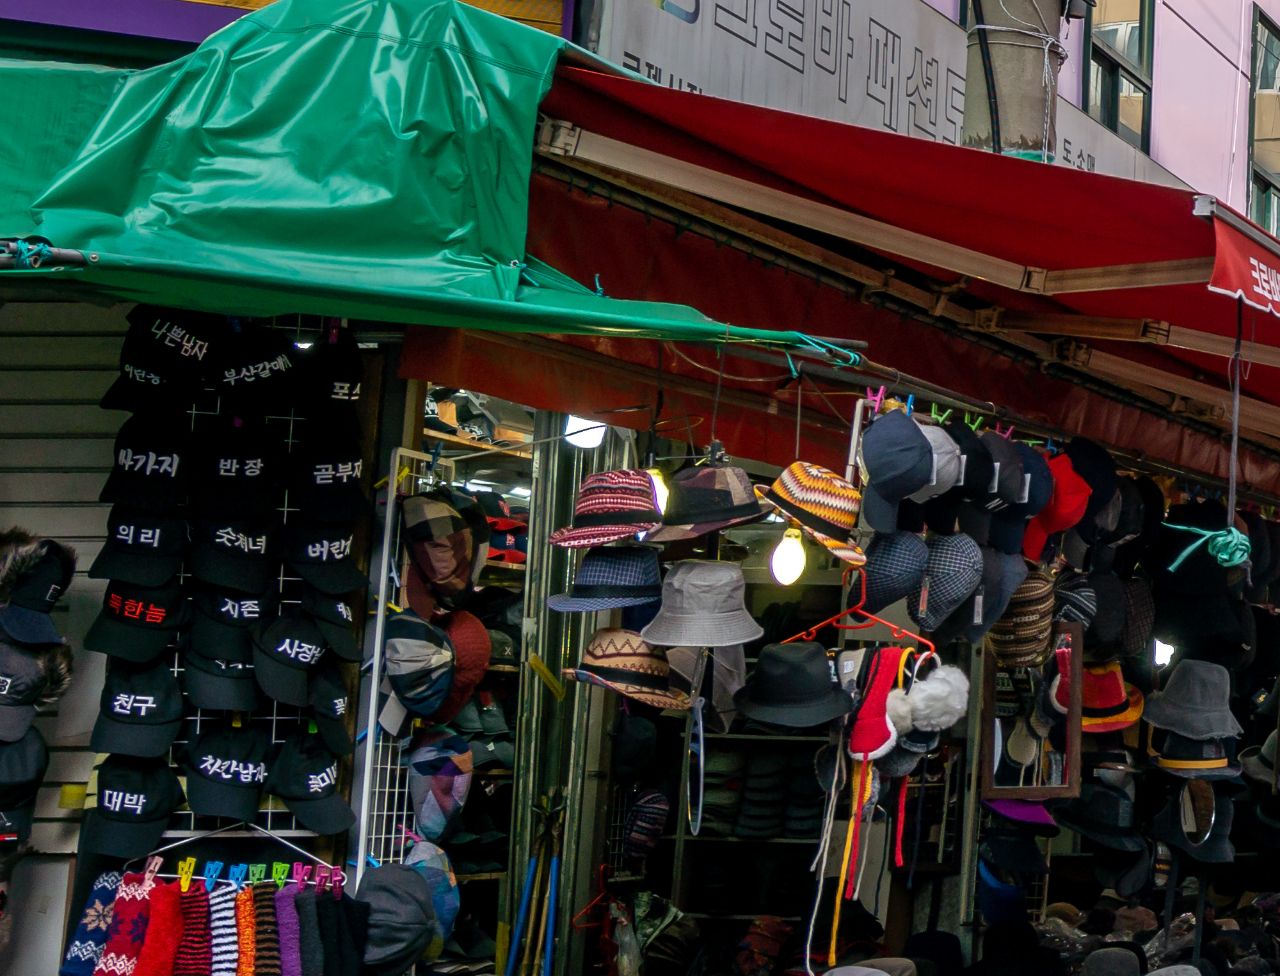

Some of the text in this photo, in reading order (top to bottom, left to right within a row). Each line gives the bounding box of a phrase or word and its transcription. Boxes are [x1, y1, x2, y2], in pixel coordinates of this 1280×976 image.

[151, 319, 209, 360] 나쁜남자
[219, 458, 264, 477] 반 장
[116, 525, 160, 547] 의 리
[221, 598, 260, 618] 지존
[114, 693, 156, 716] 친구
[103, 789, 146, 815] 대박
